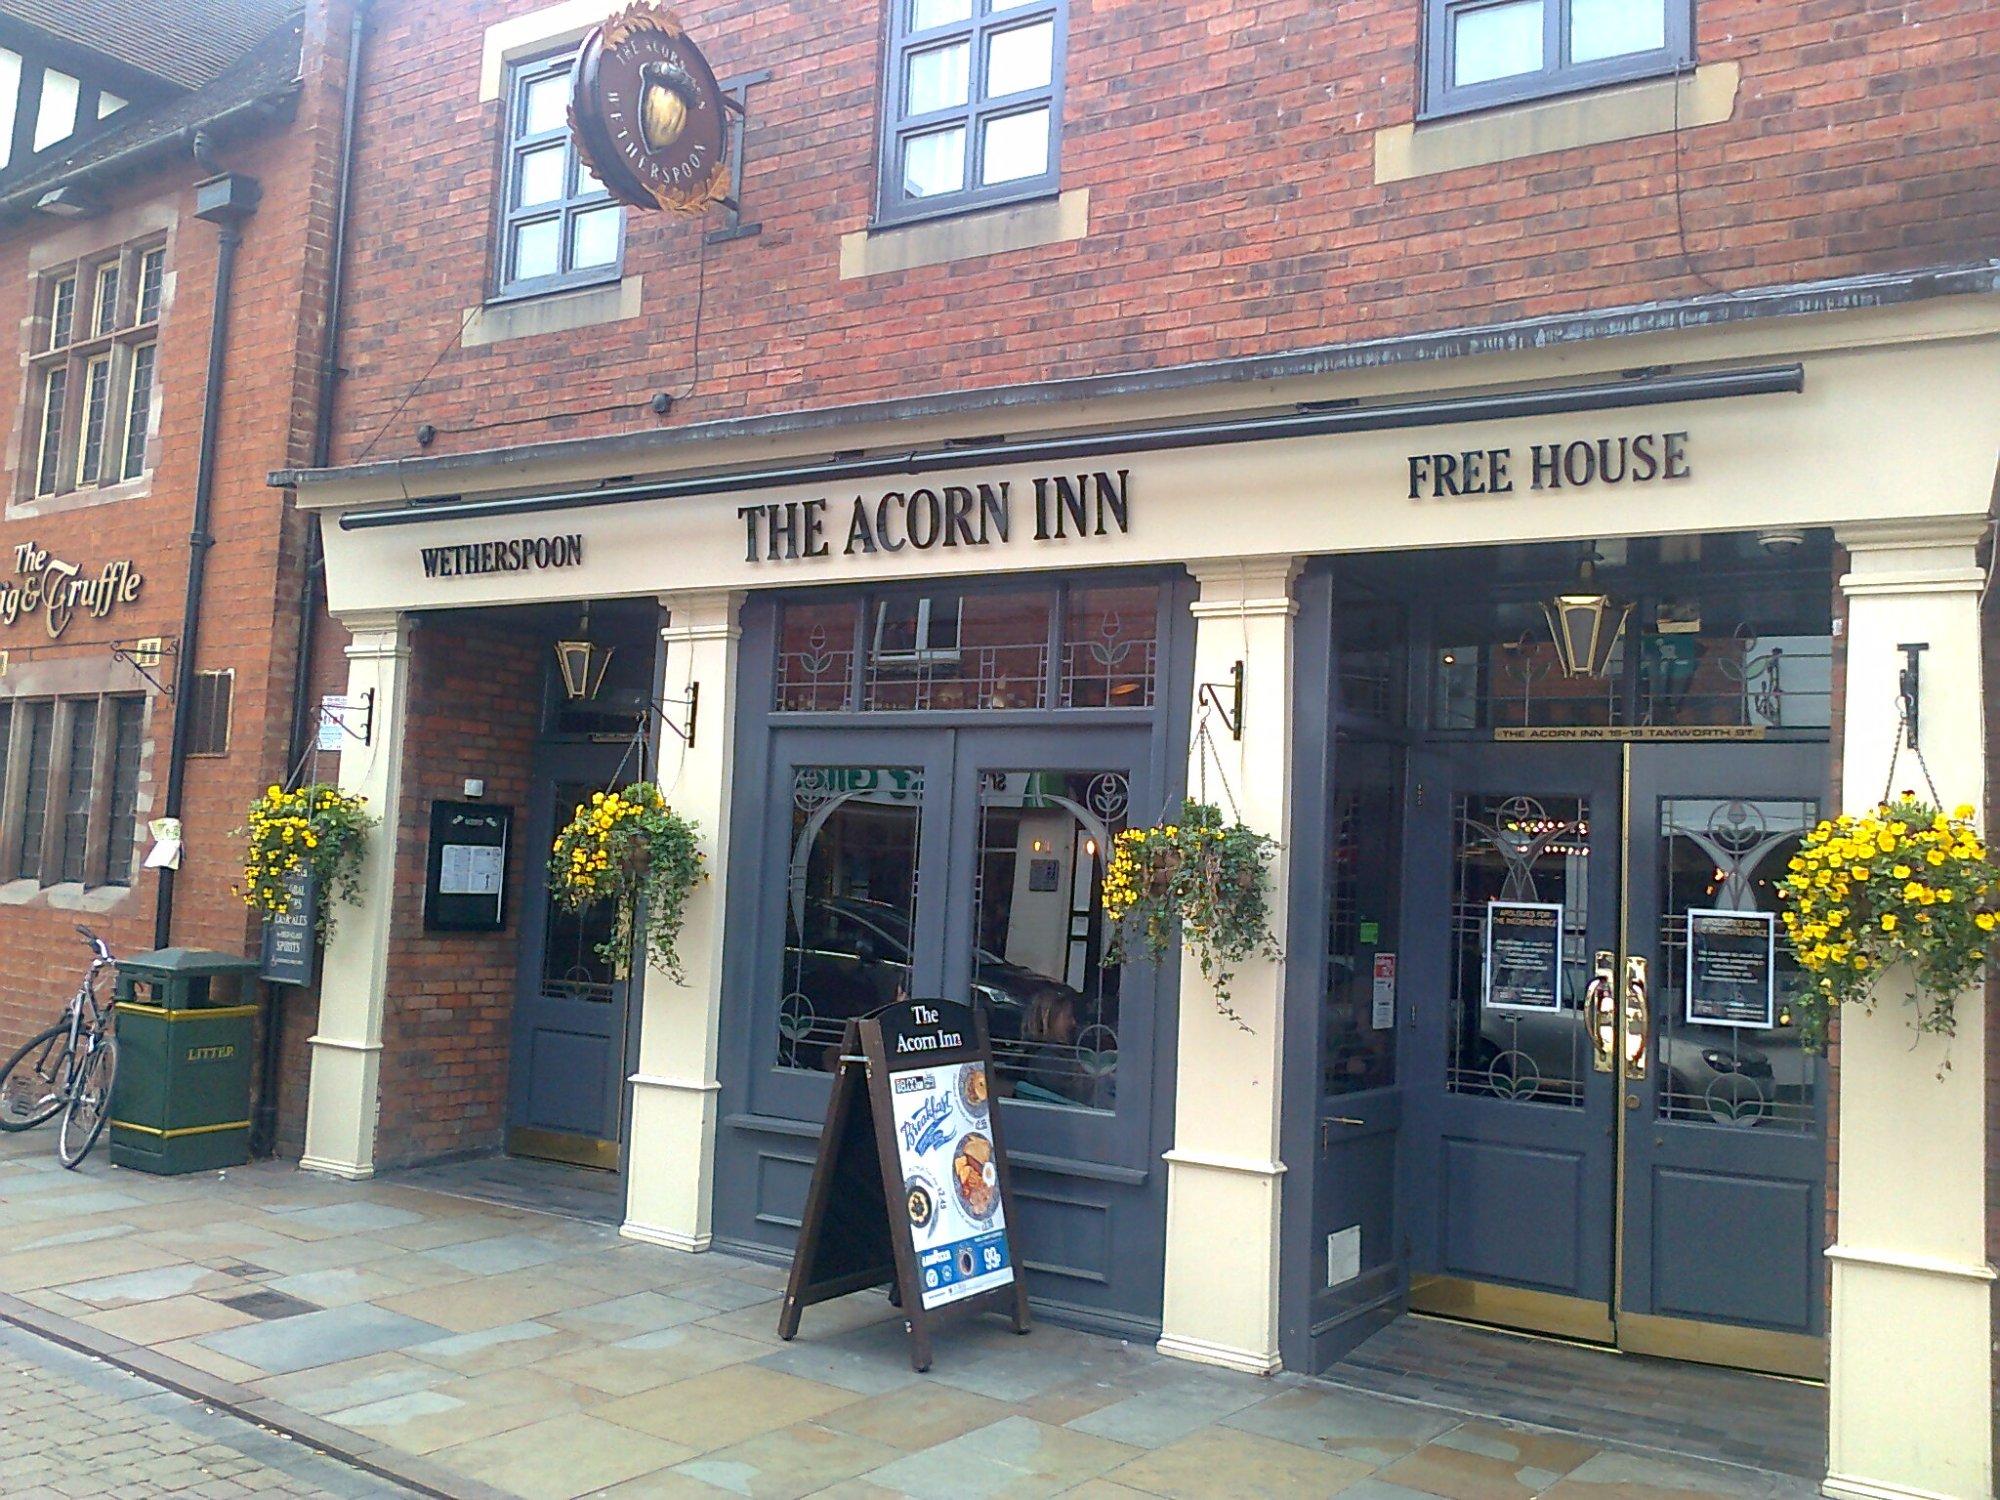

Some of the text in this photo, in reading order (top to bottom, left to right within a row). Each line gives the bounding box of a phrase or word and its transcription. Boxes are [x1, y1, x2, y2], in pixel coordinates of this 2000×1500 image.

[1407, 431, 1690, 499] FREE HOUSE
[738, 469, 1131, 563] THE ACORN INN
[15, 541, 48, 573] The
[420, 533, 583, 578] WETHERSPOON
[0, 582, 20, 625] ig
[42, 559, 143, 639] Truffle
[1502, 730, 1525, 738] THE
[1530, 730, 1576, 738] ACORN
[1580, 730, 1602, 738] INN
[1648, 729, 1731, 737] TAMWORTH
[911, 1005, 940, 1025] The
[187, 1045, 235, 1061] LITTER
[896, 1029, 963, 1053] Acorn Inn
